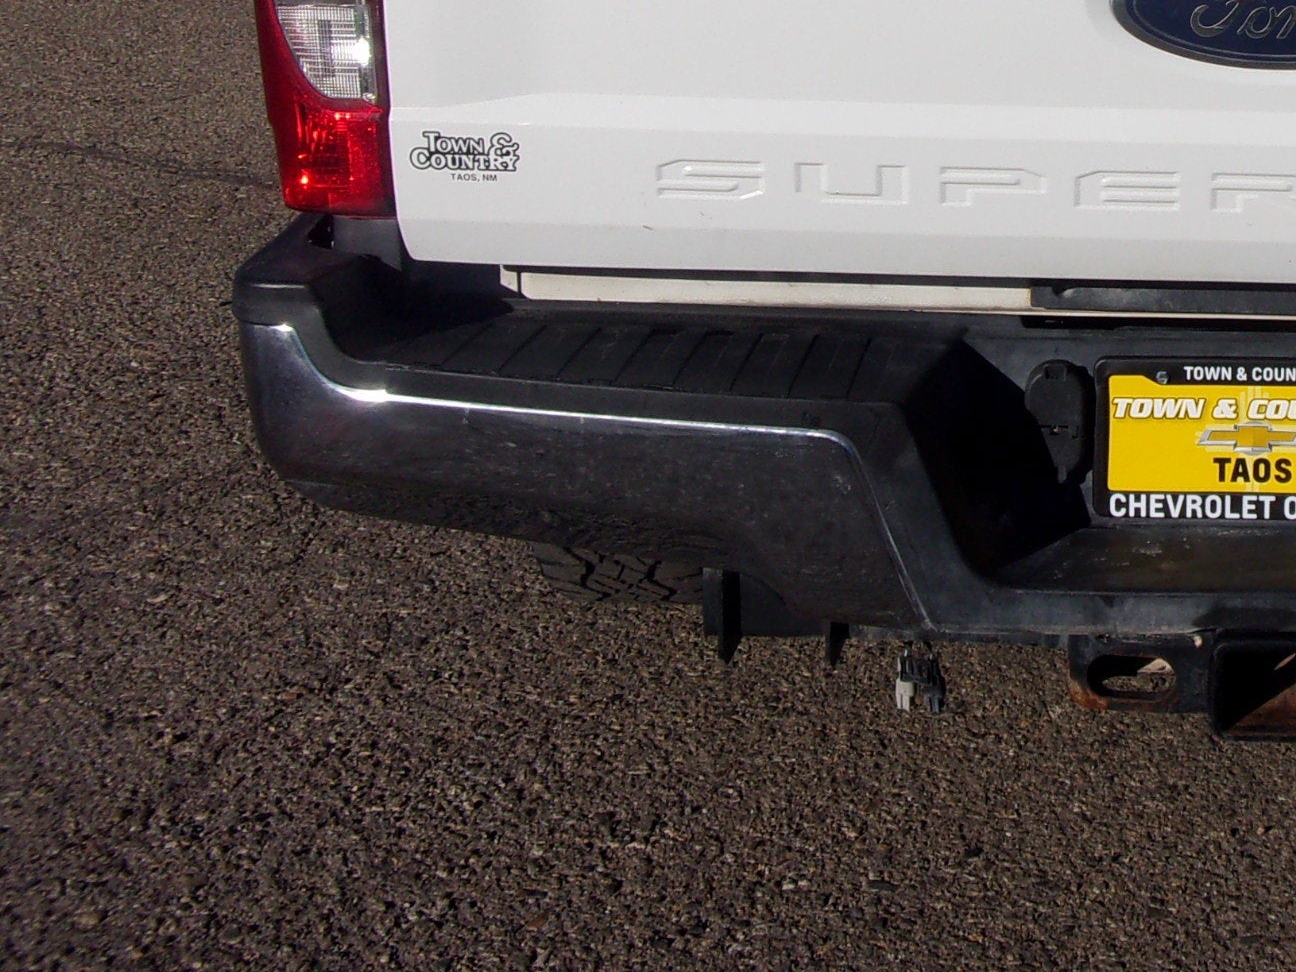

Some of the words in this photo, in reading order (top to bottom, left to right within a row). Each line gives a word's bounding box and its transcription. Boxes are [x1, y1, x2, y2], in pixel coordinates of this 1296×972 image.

[422, 131, 485, 154] TOWN
[487, 132, 520, 158] &
[410, 147, 520, 171] COUNTRY
[450, 173, 480, 182] TAOS,
[482, 174, 497, 182] NM
[1184, 366, 1231, 381] TOWN
[1236, 367, 1248, 381] &
[1112, 397, 1206, 419] TOWN
[1212, 398, 1238, 419] &
[1212, 457, 1293, 483] TAOS
[1108, 493, 1276, 520] CHEVROLET
